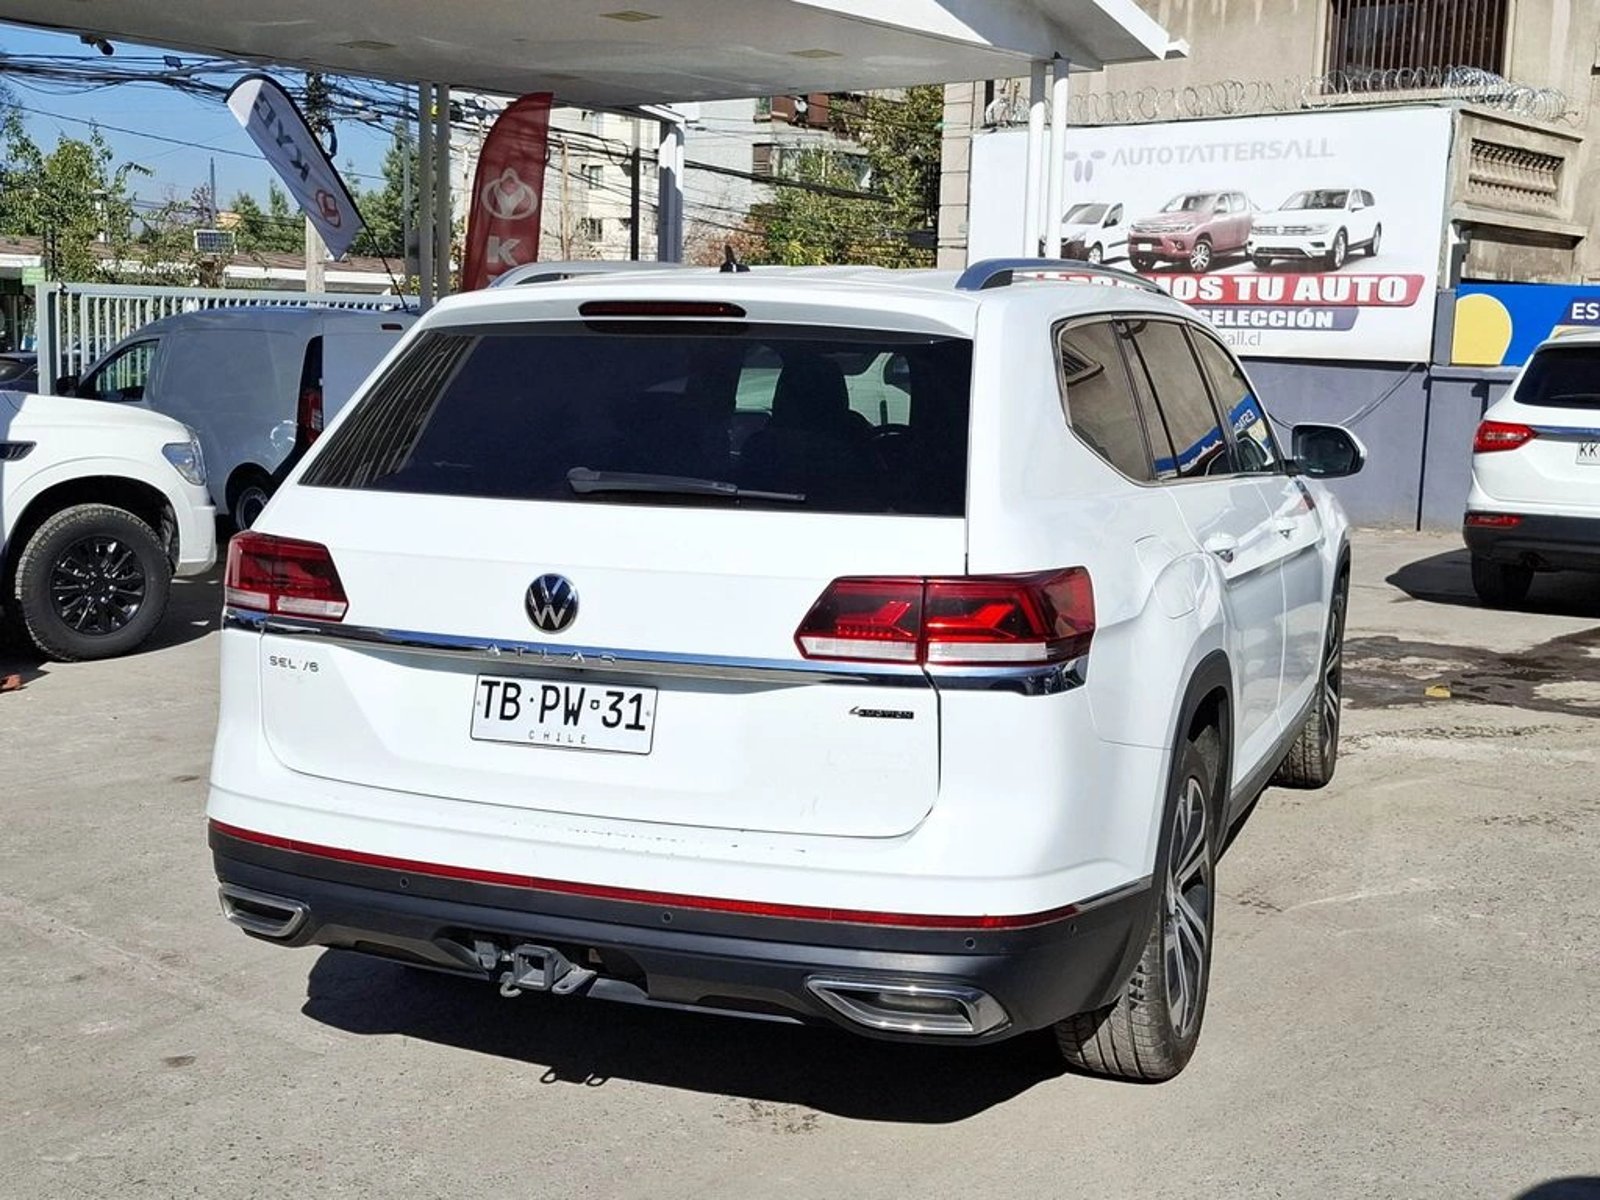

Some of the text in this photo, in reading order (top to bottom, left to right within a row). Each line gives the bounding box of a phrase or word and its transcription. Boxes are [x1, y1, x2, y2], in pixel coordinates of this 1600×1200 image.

[1111, 137, 1335, 168] AUTOTATTERSALL
[1234, 276, 1285, 302] TU
[1292, 276, 1408, 303] AUTO
[1200, 306, 1334, 329] SELECCIÓN
[1571, 302, 1600, 321] ES
[269, 655, 297, 670] SEL
[528, 729, 587, 745] CHILE
